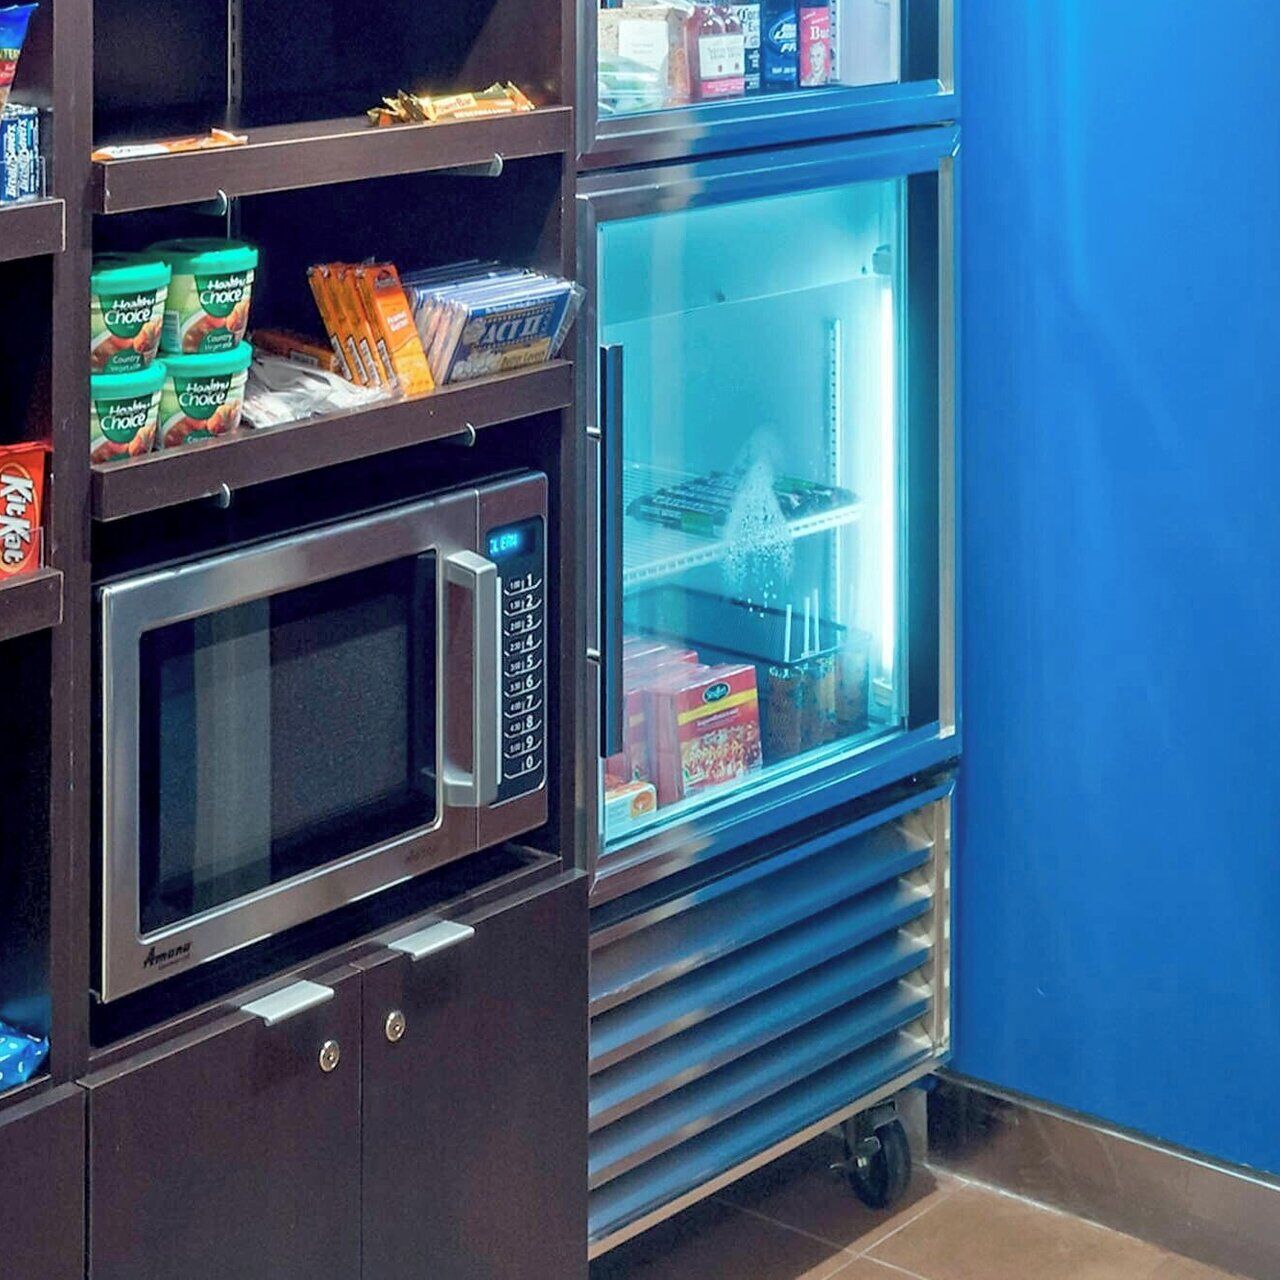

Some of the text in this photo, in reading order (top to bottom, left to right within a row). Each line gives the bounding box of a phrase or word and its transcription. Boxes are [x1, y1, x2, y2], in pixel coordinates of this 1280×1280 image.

[207, 274, 247, 290] Healthy
[113, 295, 155, 309] Healthy
[200, 289, 242, 305] Choice
[104, 307, 150, 325] Choice
[186, 378, 229, 392] Healthy
[179, 391, 225, 407] Choice
[101, 412, 146, 431] Choice
[526, 573, 533, 587] 1
[526, 594, 533, 608] 2
[526, 614, 533, 628] 3
[526, 634, 533, 648] 4
[526, 654, 533, 668] 5
[526, 674, 533, 688] 6
[526, 694, 533, 708] 7
[526, 715, 533, 728] 8
[526, 735, 533, 749] 9
[526, 755, 534, 769] 0
